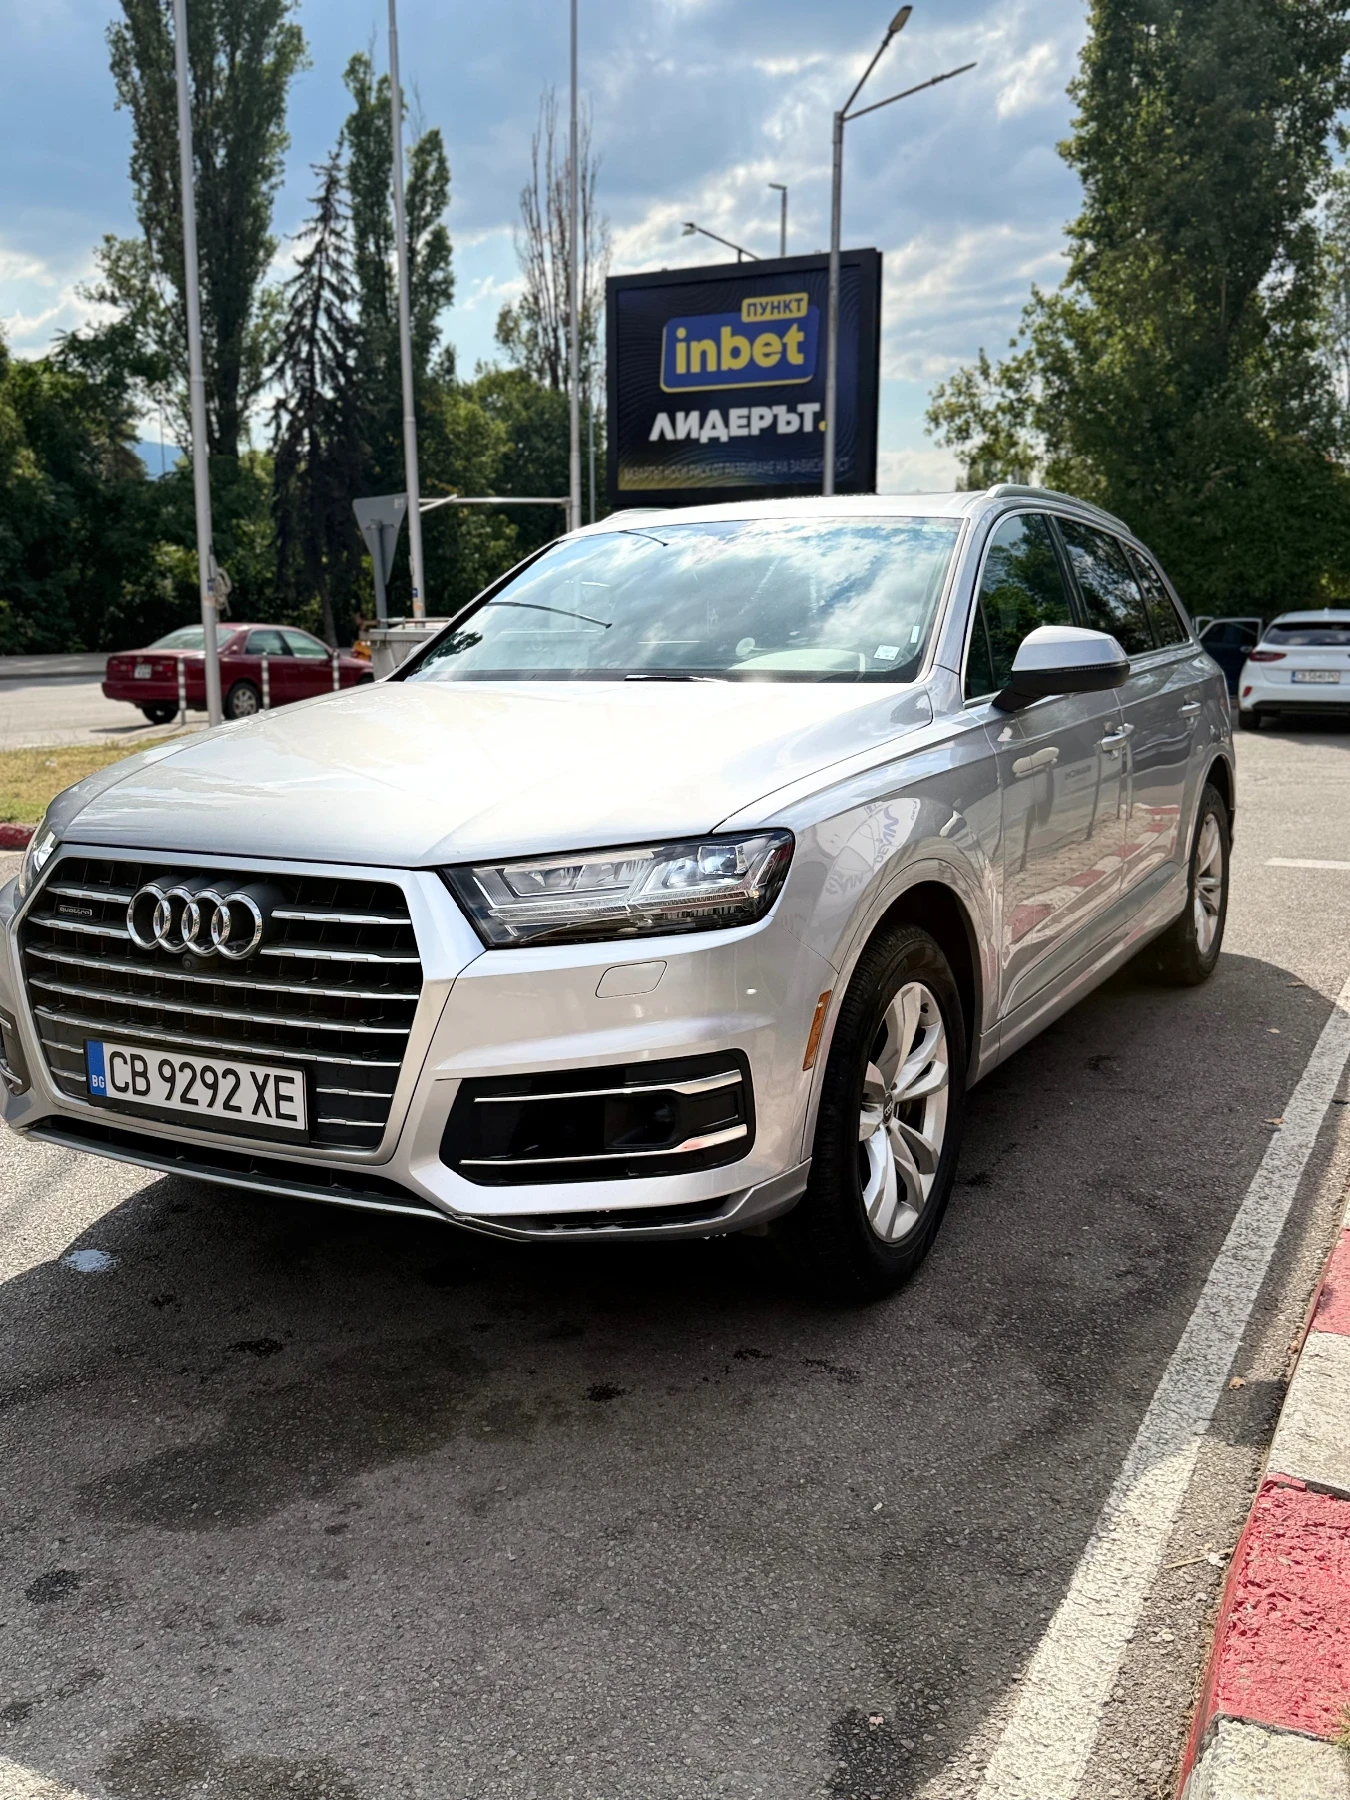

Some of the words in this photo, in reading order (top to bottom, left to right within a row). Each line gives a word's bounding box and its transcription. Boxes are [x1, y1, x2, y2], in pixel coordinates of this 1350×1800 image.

[746, 297, 805, 318] ПУНКТ
[675, 323, 805, 375] inbet
[91, 1074, 105, 1088] BG
[109, 1050, 151, 1097] CB
[157, 1058, 242, 1113] 9292
[249, 1070, 298, 1122] XE
